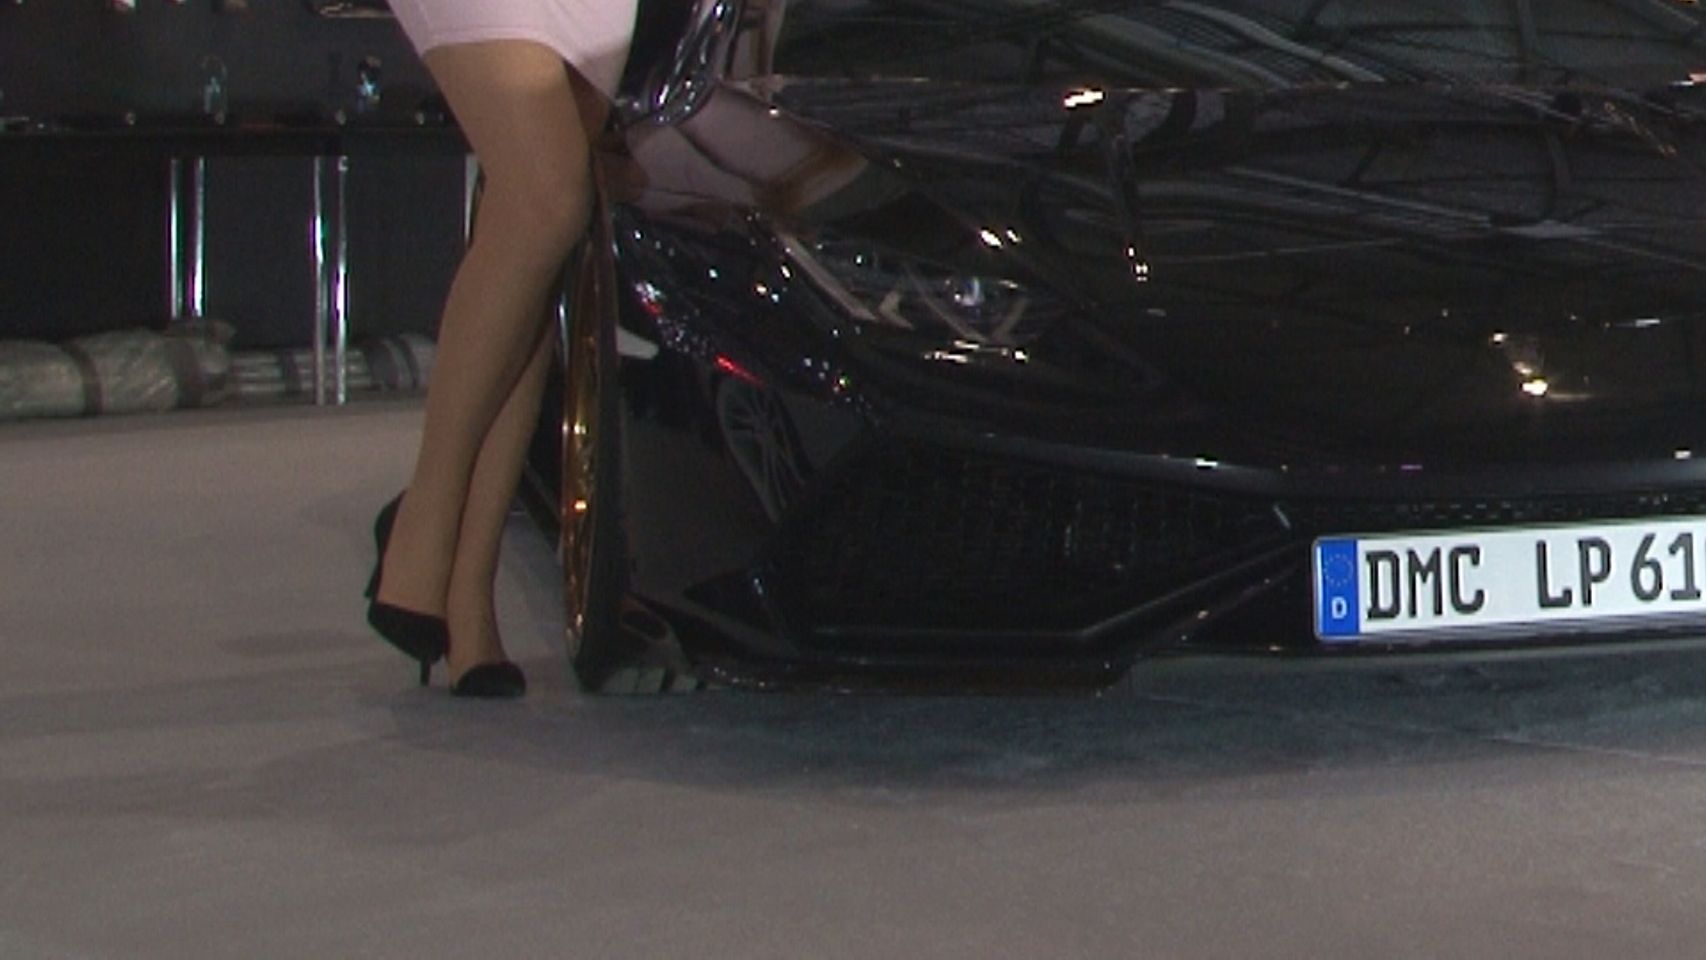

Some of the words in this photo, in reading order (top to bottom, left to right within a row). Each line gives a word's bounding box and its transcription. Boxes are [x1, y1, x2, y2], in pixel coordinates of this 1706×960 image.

[1364, 544, 1486, 621] DMC
[1536, 539, 1612, 608] LP
[1330, 596, 1348, 619] D
